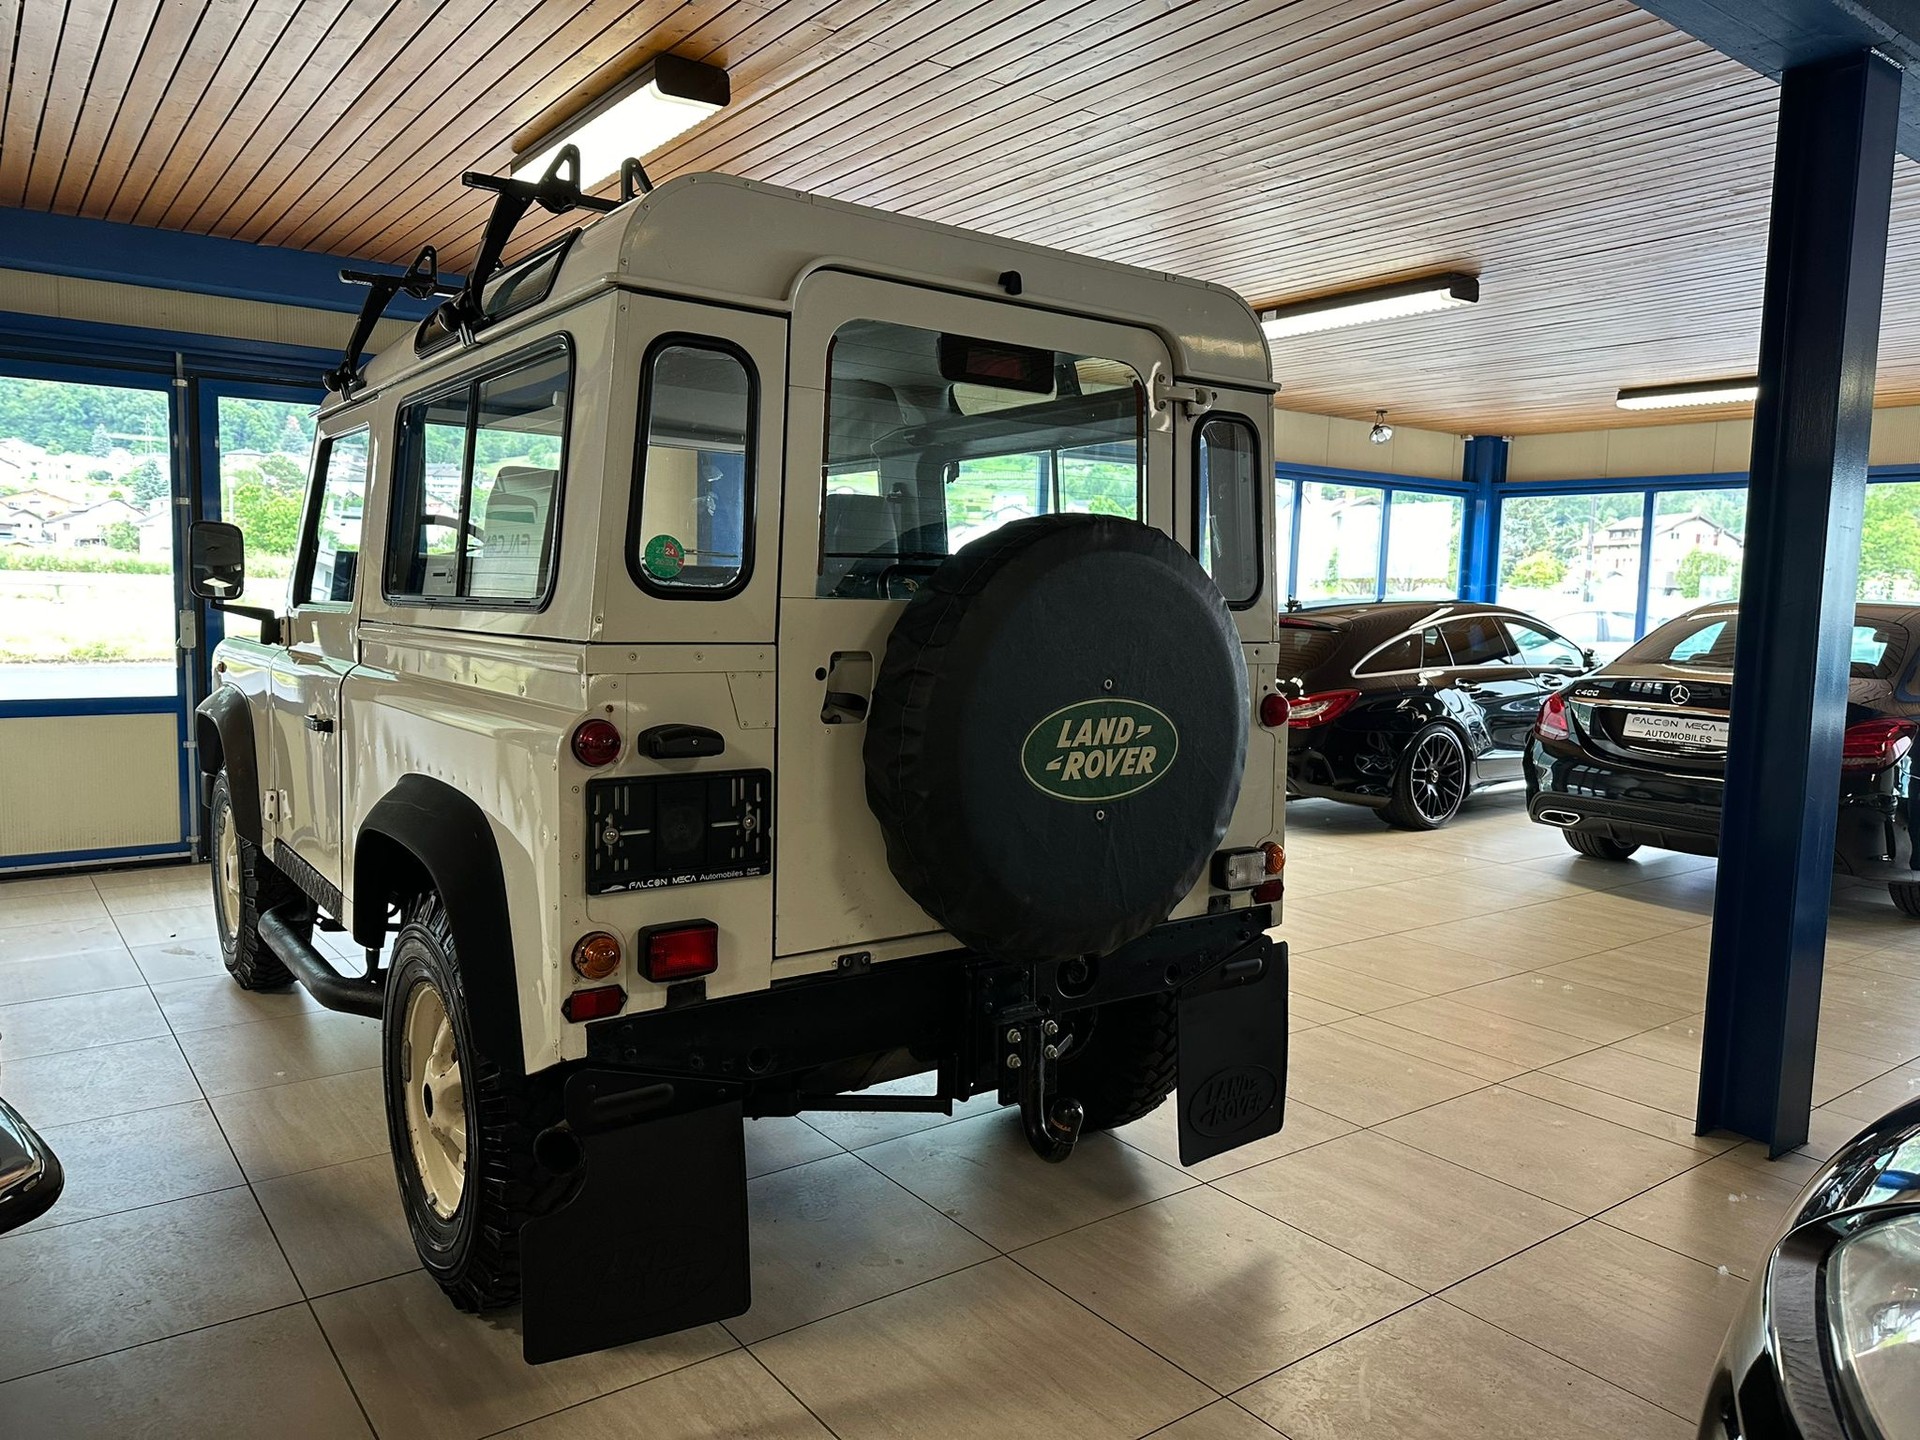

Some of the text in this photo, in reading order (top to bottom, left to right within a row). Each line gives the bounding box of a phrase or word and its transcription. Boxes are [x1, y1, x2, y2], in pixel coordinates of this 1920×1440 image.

[665, 548, 675, 556] 24
[1056, 716, 1136, 748] LAND
[1632, 716, 1679, 728] FALCON
[1684, 721, 1717, 732] MECA
[1644, 729, 1713, 744] AUTOMOBILES
[1060, 745, 1157, 782] ROVER
[628, 877, 668, 890] FALCON
[672, 874, 697, 885] MECA
[699, 870, 744, 881] Automobiles
